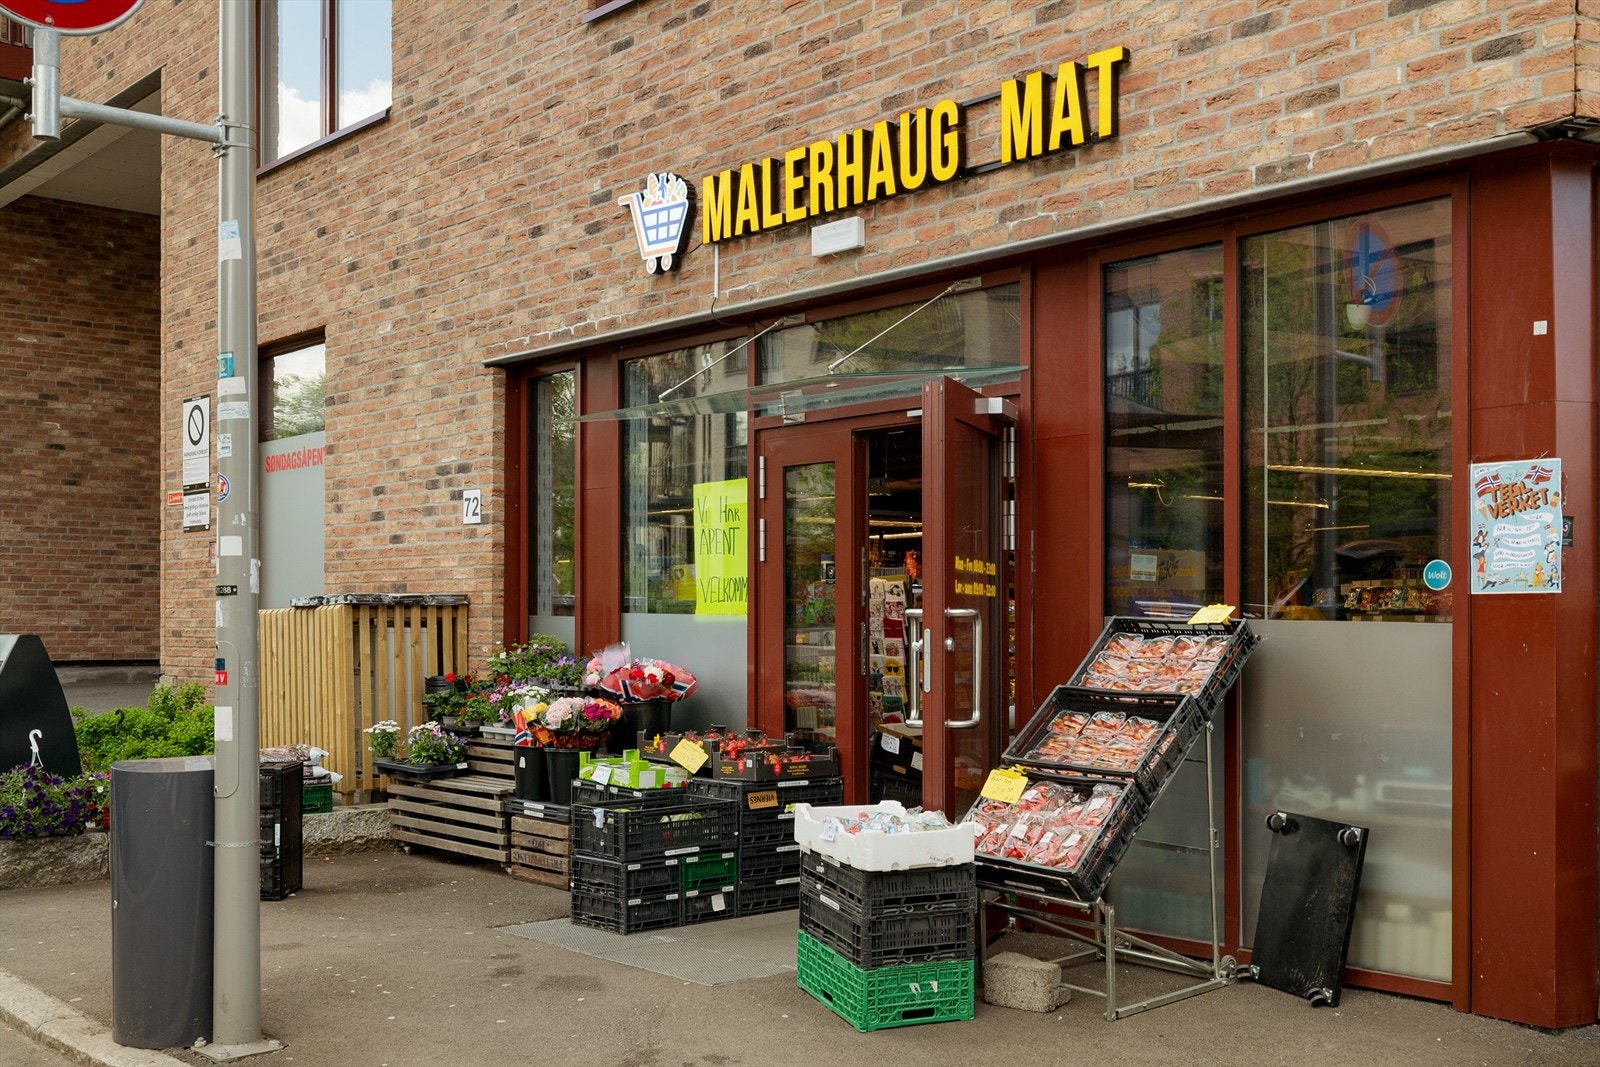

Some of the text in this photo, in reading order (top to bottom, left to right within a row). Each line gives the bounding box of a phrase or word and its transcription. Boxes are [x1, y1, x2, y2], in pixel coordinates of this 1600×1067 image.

[702, 46, 1126, 245] MALERHAUG MAT
[1485, 480, 1533, 502] TEGL
[464, 496, 480, 517] 72
[1488, 488, 1549, 520] VERKET
[1428, 570, 1447, 579] Wolt
[750, 794, 775, 805] VIERNES
